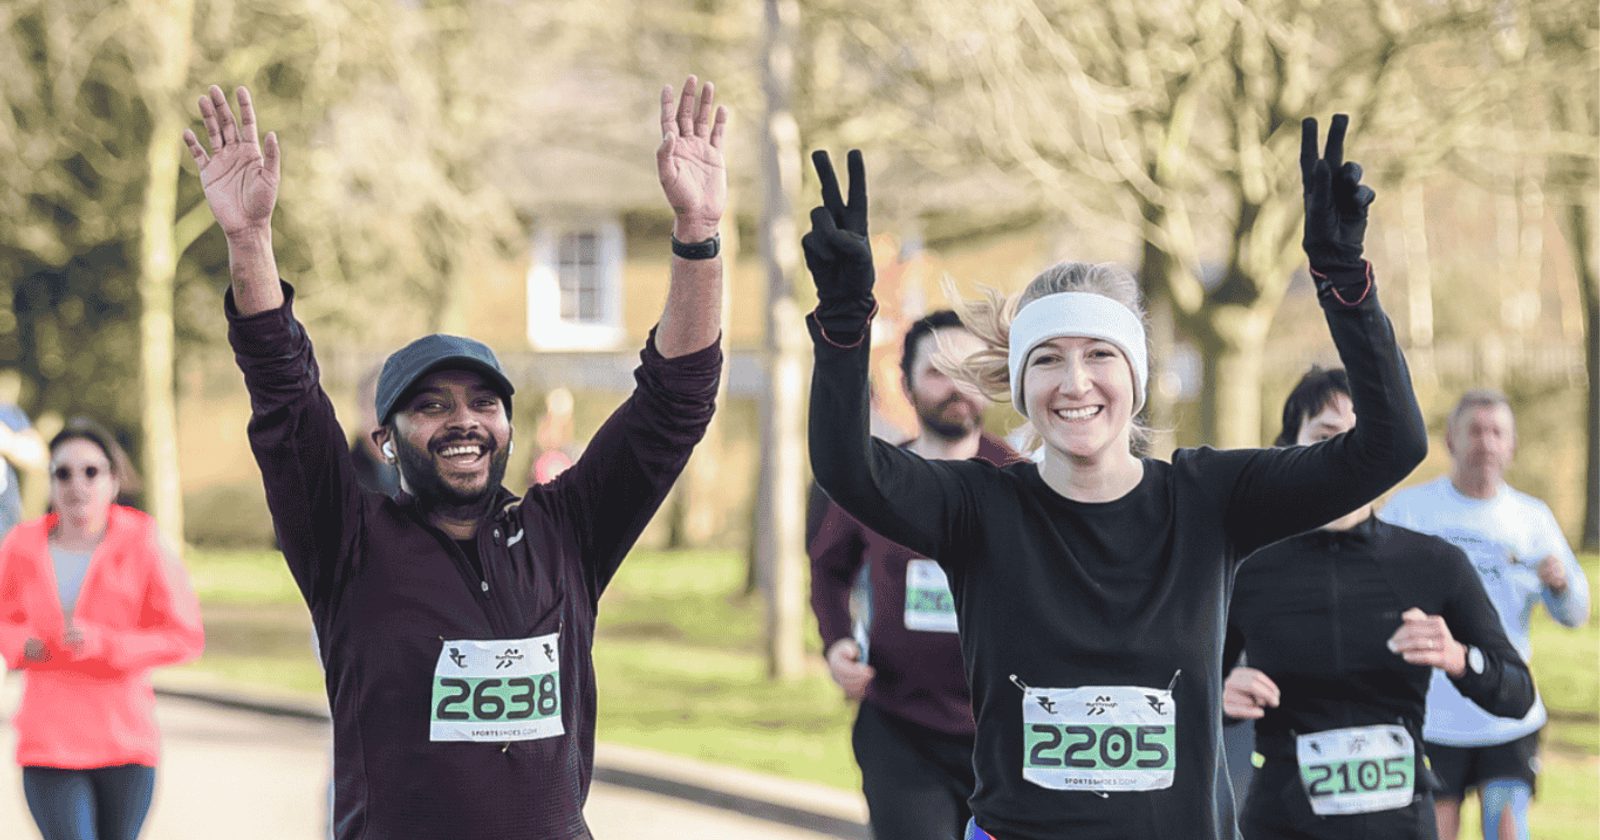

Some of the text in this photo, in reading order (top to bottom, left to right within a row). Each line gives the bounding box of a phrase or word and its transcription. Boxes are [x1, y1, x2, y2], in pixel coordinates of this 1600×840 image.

[436, 674, 558, 720] 2638
[1030, 724, 1169, 768] 2205
[1309, 758, 1406, 796] 2105
